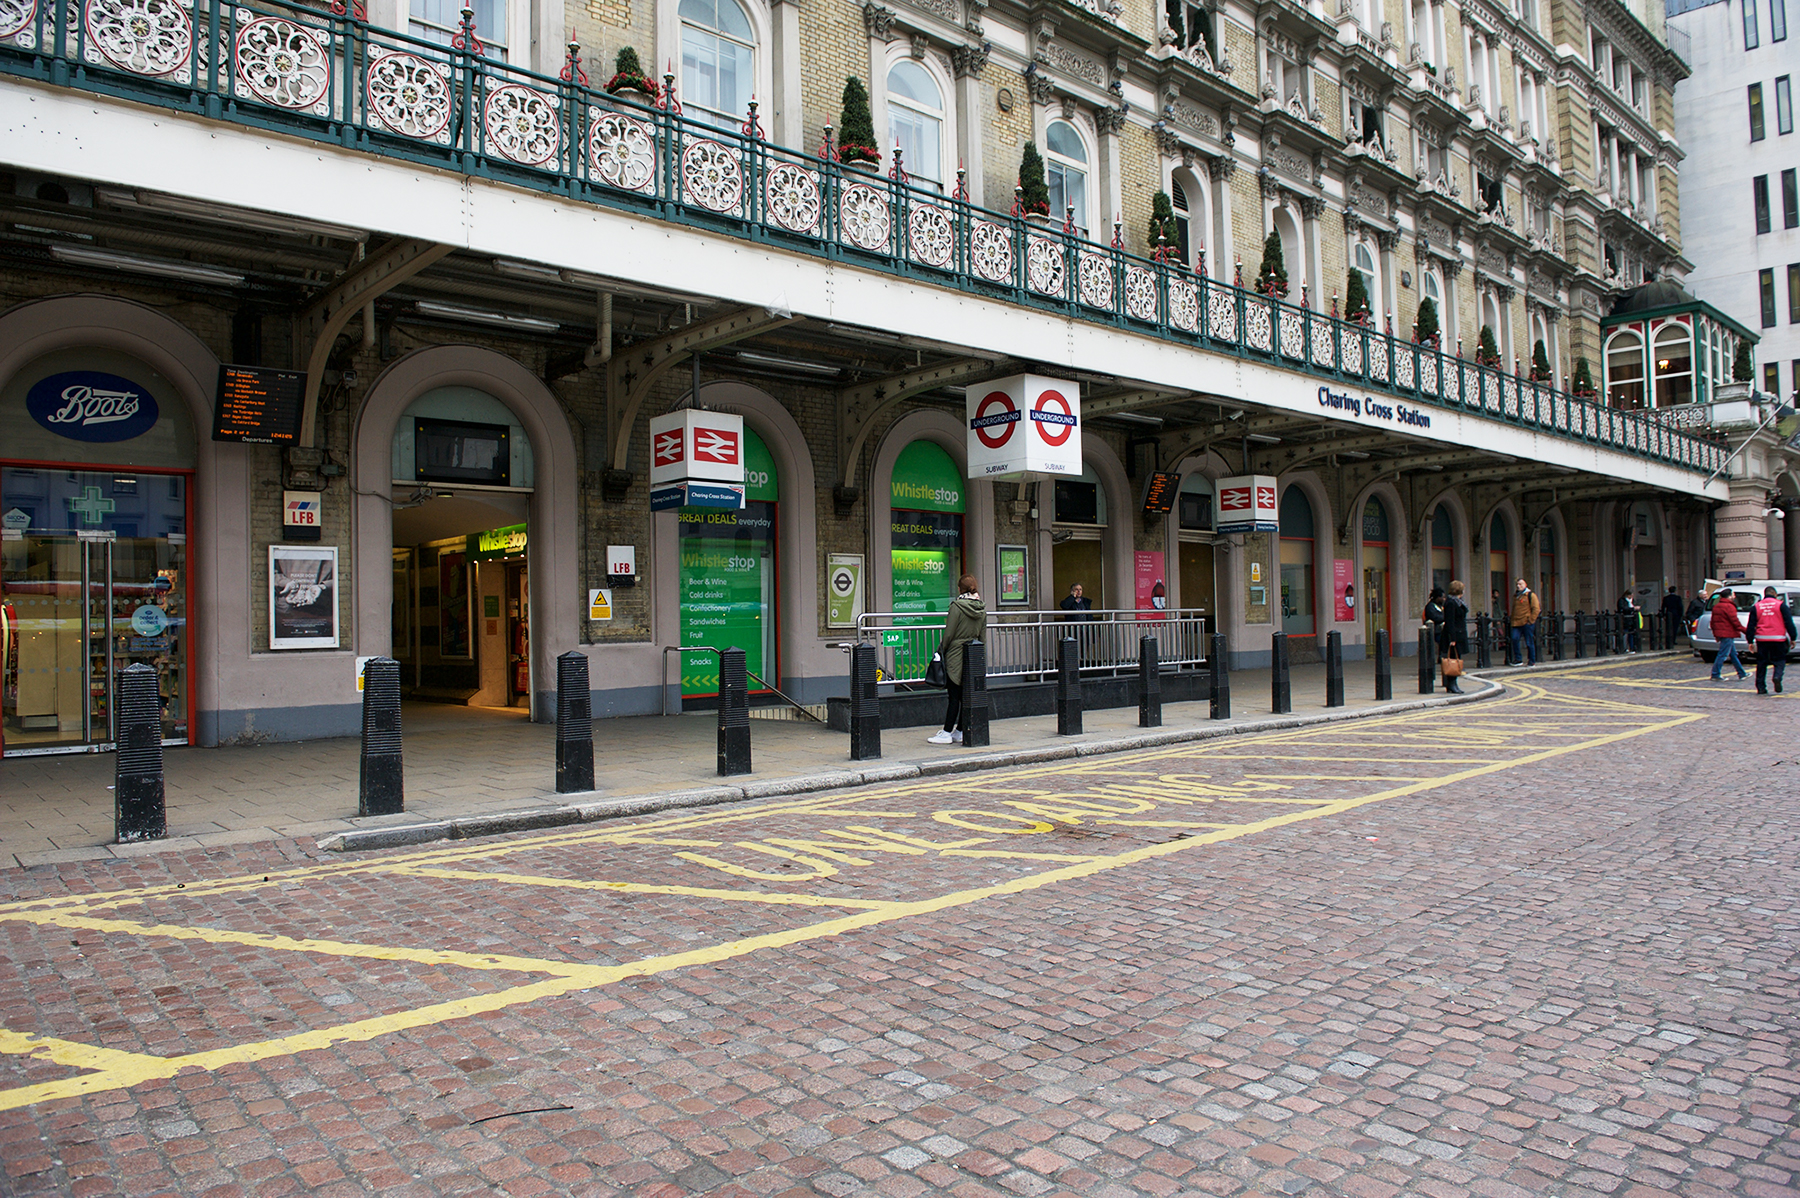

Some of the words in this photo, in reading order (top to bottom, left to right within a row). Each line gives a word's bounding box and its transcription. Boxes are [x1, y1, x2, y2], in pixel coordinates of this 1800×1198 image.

[47, 385, 139, 426] Boots
[1318, 386, 1361, 417] Charing
[1364, 397, 1393, 421] Cross
[1397, 404, 1430, 428] Station
[973, 412, 1020, 427] UNDERGROUND
[1031, 412, 1075, 425] UNDERGROUND
[242, 436, 273, 444] Departures
[986, 463, 1009, 474] SUBWAY
[1044, 463, 1066, 471] SUBWAY
[691, 492, 708, 500] Charing
[892, 482, 959, 506] Whistlestop
[292, 511, 314, 524] LFB
[707, 514, 737, 525] DEALS
[738, 518, 771, 528] everyday
[911, 524, 933, 535] DEALS
[934, 528, 959, 538] everyday
[478, 530, 528, 553] Whistlestop
[614, 562, 630, 574] LFB
[681, 552, 755, 572] Whistlestop
[711, 578, 727, 586] Wine
[689, 591, 704, 599] Cold
[704, 591, 724, 599] drinks
[689, 604, 732, 613] Confectionery
[894, 602, 926, 610] Confectionery
[689, 618, 726, 626] Sandwiches
[689, 631, 704, 639] Fruit
[690, 658, 712, 666] Snacks
[673, 773, 1294, 882] UNLOADING
